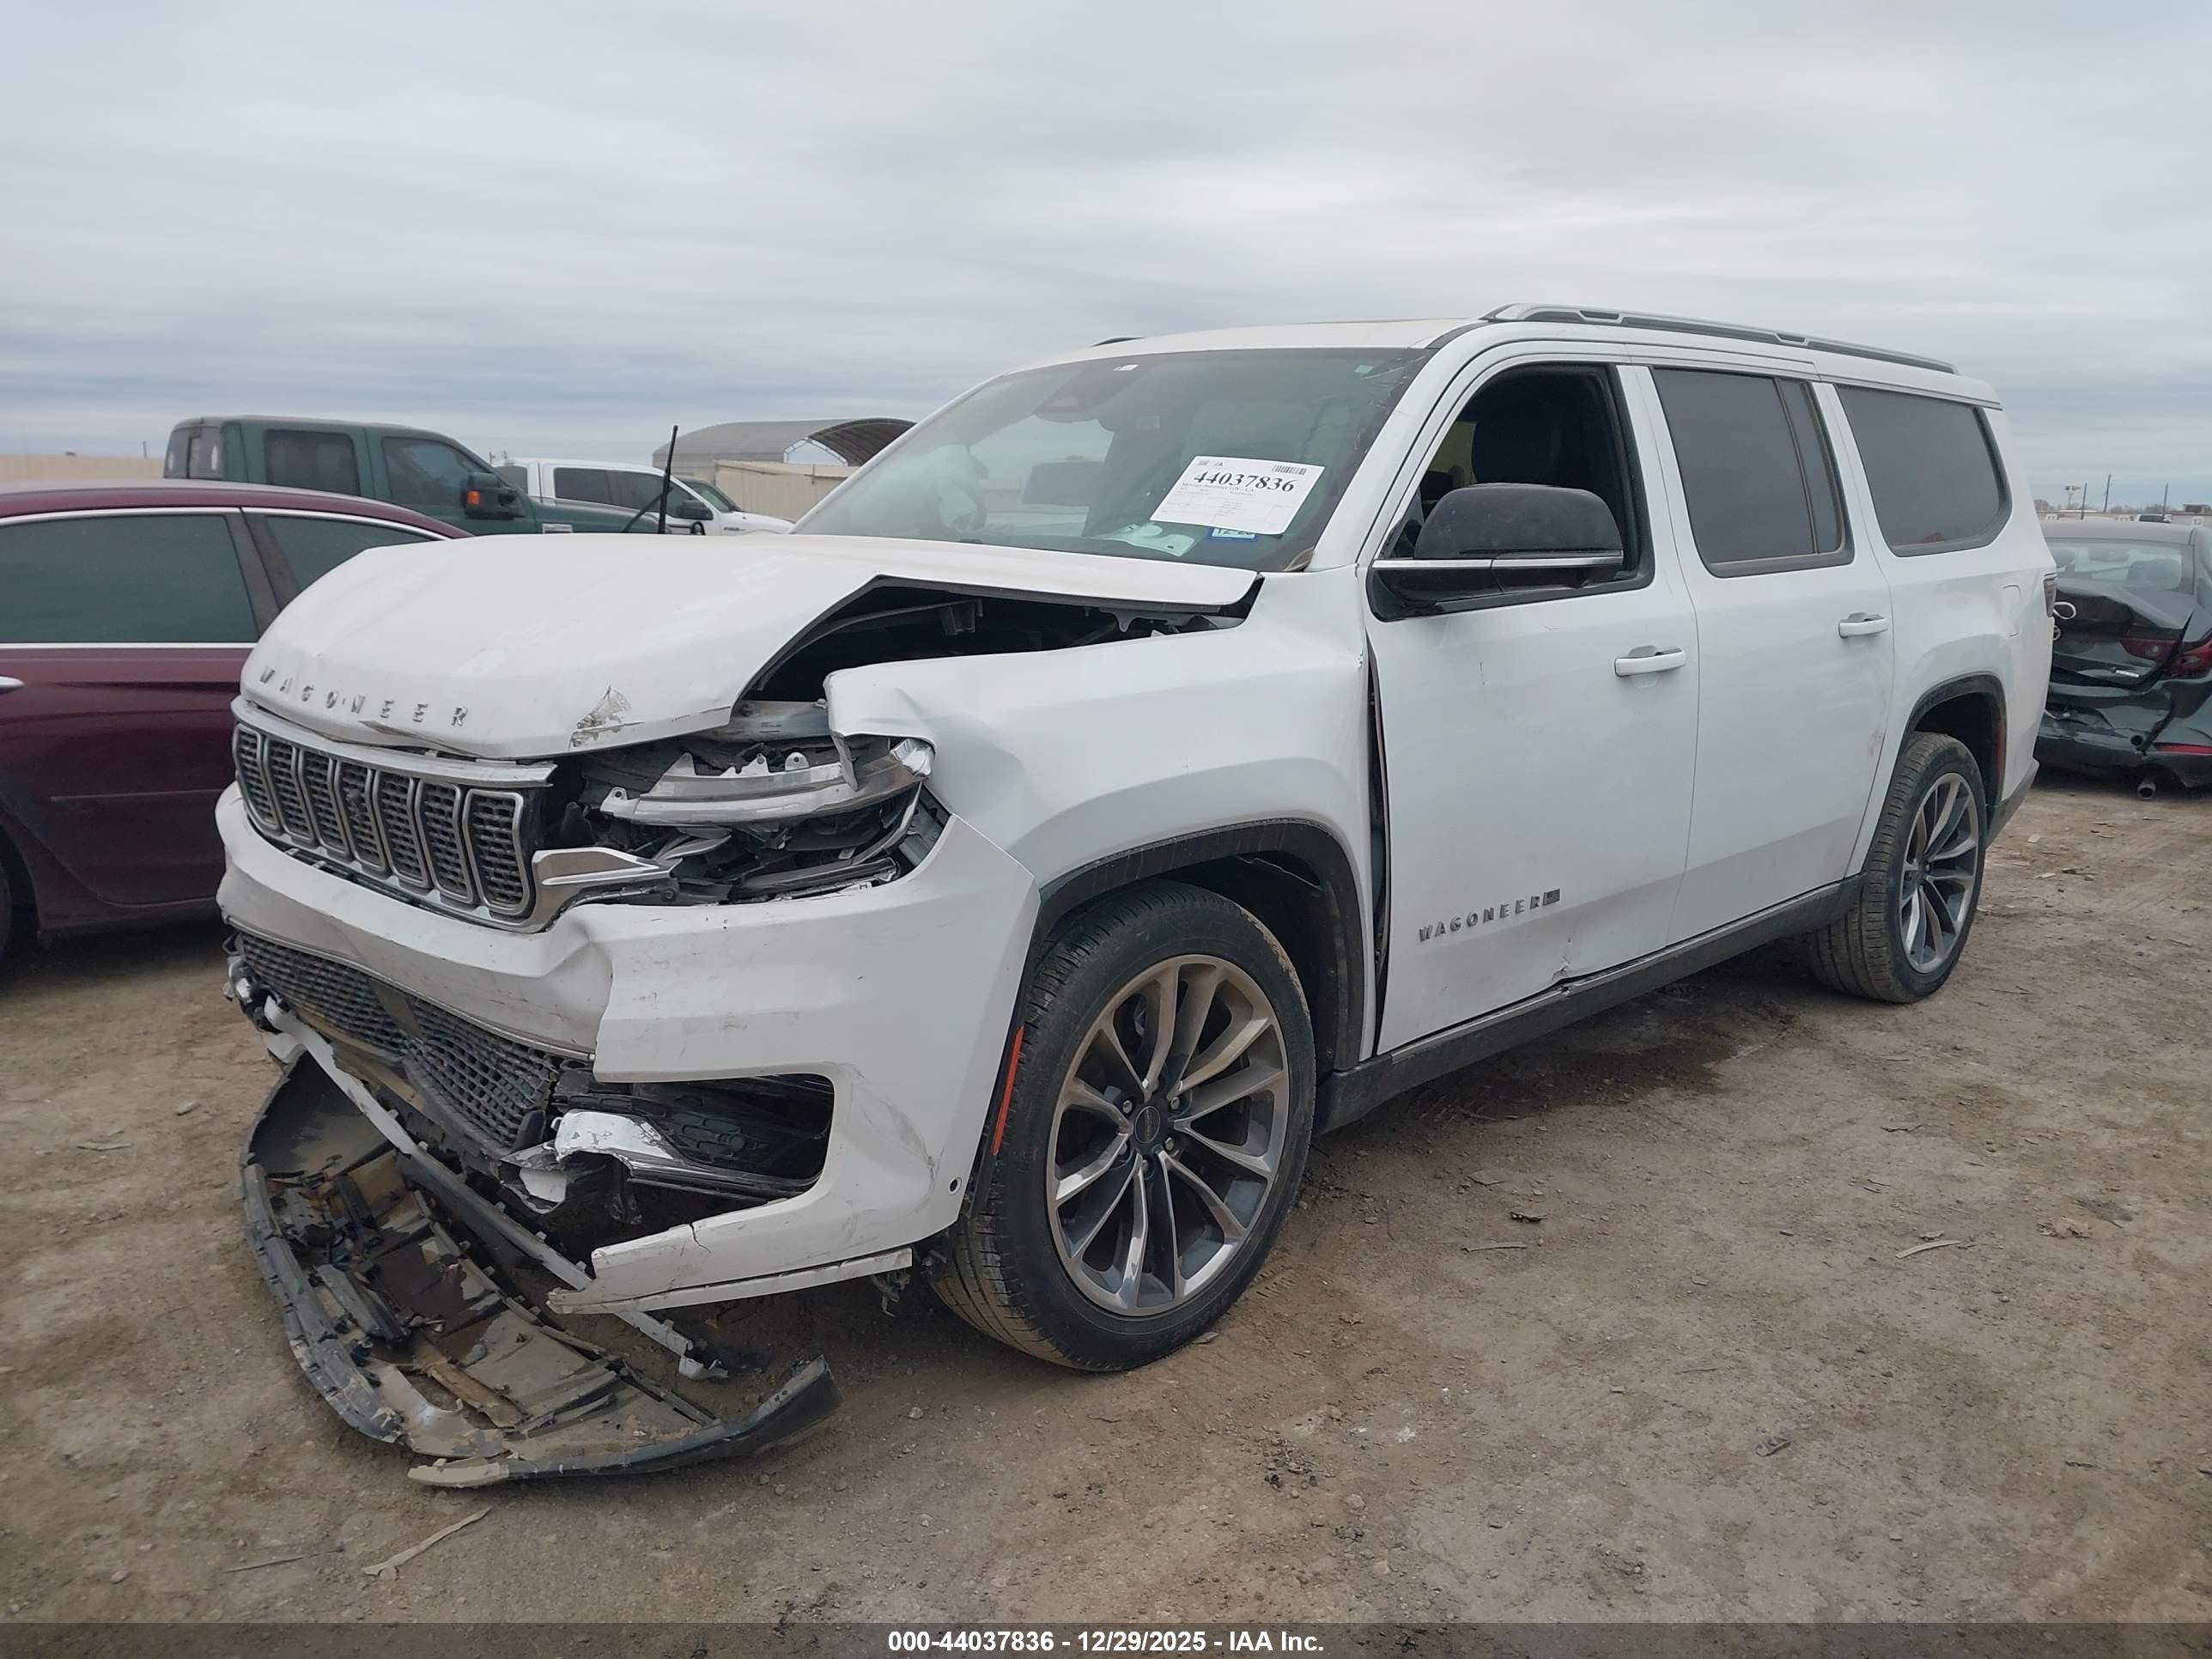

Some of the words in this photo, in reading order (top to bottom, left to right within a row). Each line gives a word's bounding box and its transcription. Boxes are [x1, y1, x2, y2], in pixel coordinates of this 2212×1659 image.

[1193, 471, 1299, 492] 44037836
[258, 665, 469, 728] WAGONEER
[1418, 895, 1540, 943] WAGONEER
